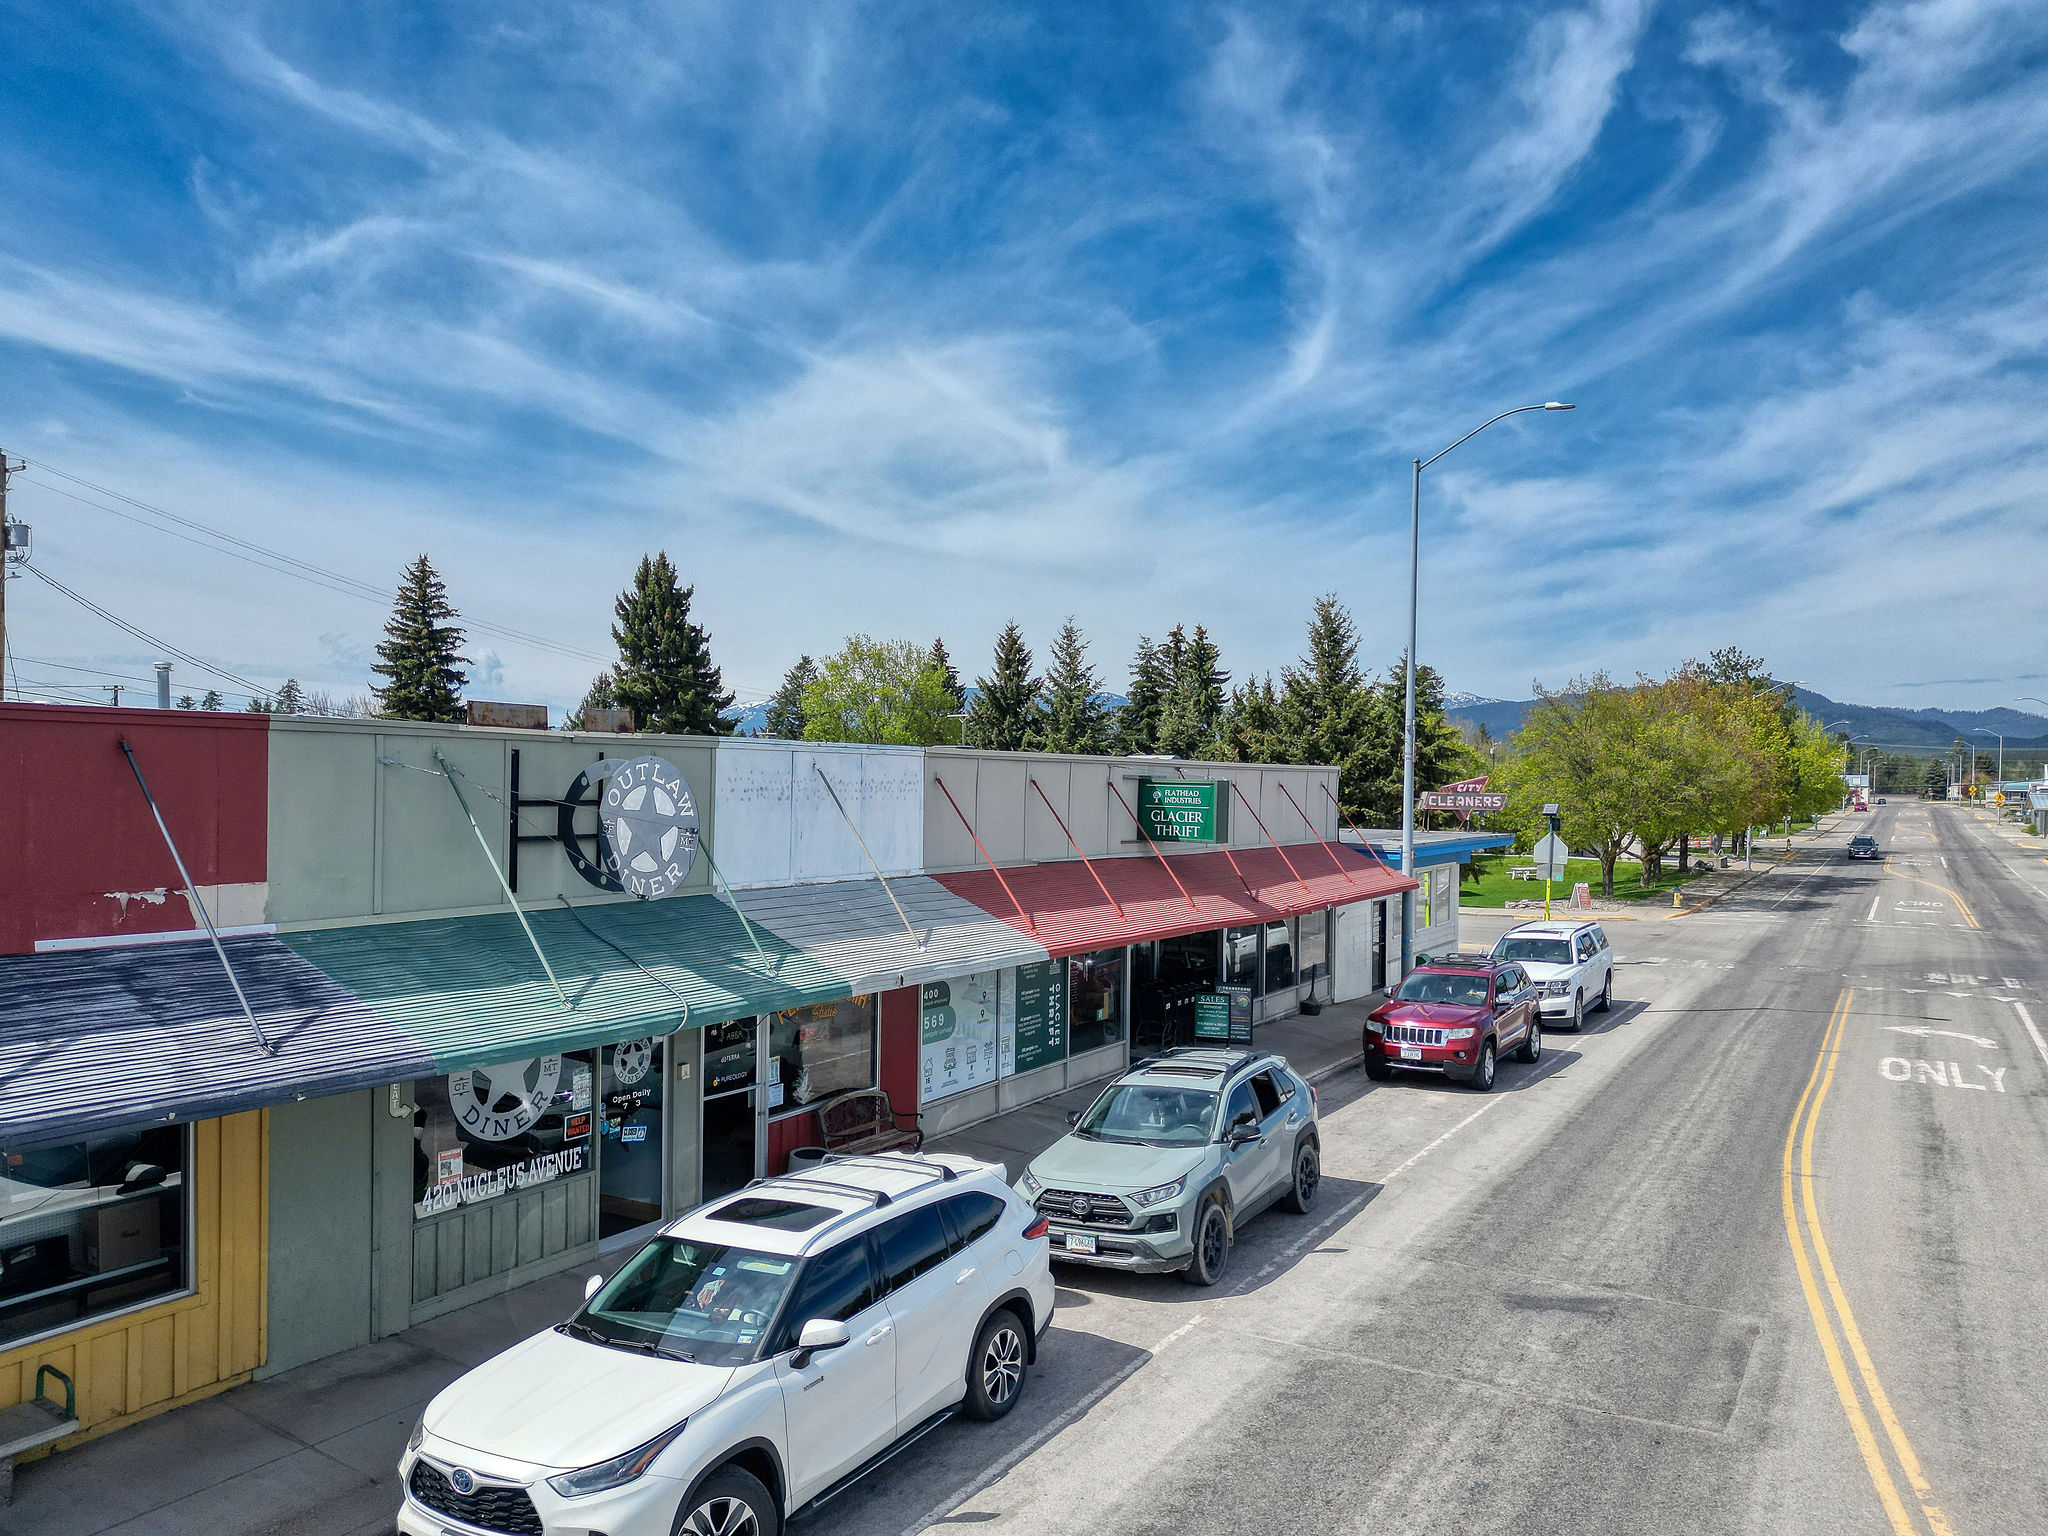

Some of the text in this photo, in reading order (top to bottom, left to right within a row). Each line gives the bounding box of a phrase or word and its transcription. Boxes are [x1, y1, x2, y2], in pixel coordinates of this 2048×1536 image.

[608, 763, 694, 817] OUTLAW
[1164, 789, 1200, 797] FLATHEAD
[1456, 784, 1483, 792] CITY
[1164, 797, 1202, 805] INDUSTRIES
[1428, 795, 1502, 807] CLEANERS
[1150, 809, 1204, 824] GLACIER
[1154, 824, 1201, 838] THRIFT
[607, 851, 683, 896] DINER
[923, 988, 939, 1000] 400
[924, 1013, 944, 1030] 569
[543, 1063, 557, 1072] MT
[618, 1066, 646, 1082] DINER
[1878, 1057, 2007, 1093] ONLY
[454, 1082, 469, 1092] CF
[612, 1087, 651, 1105] Open Daily
[622, 1099, 641, 1110] 7 3
[462, 1089, 548, 1137] DINER
[570, 1116, 586, 1126] HELP
[567, 1124, 590, 1136] WANTED
[421, 1146, 583, 1213] 420 NUCLEUS AVENUE
